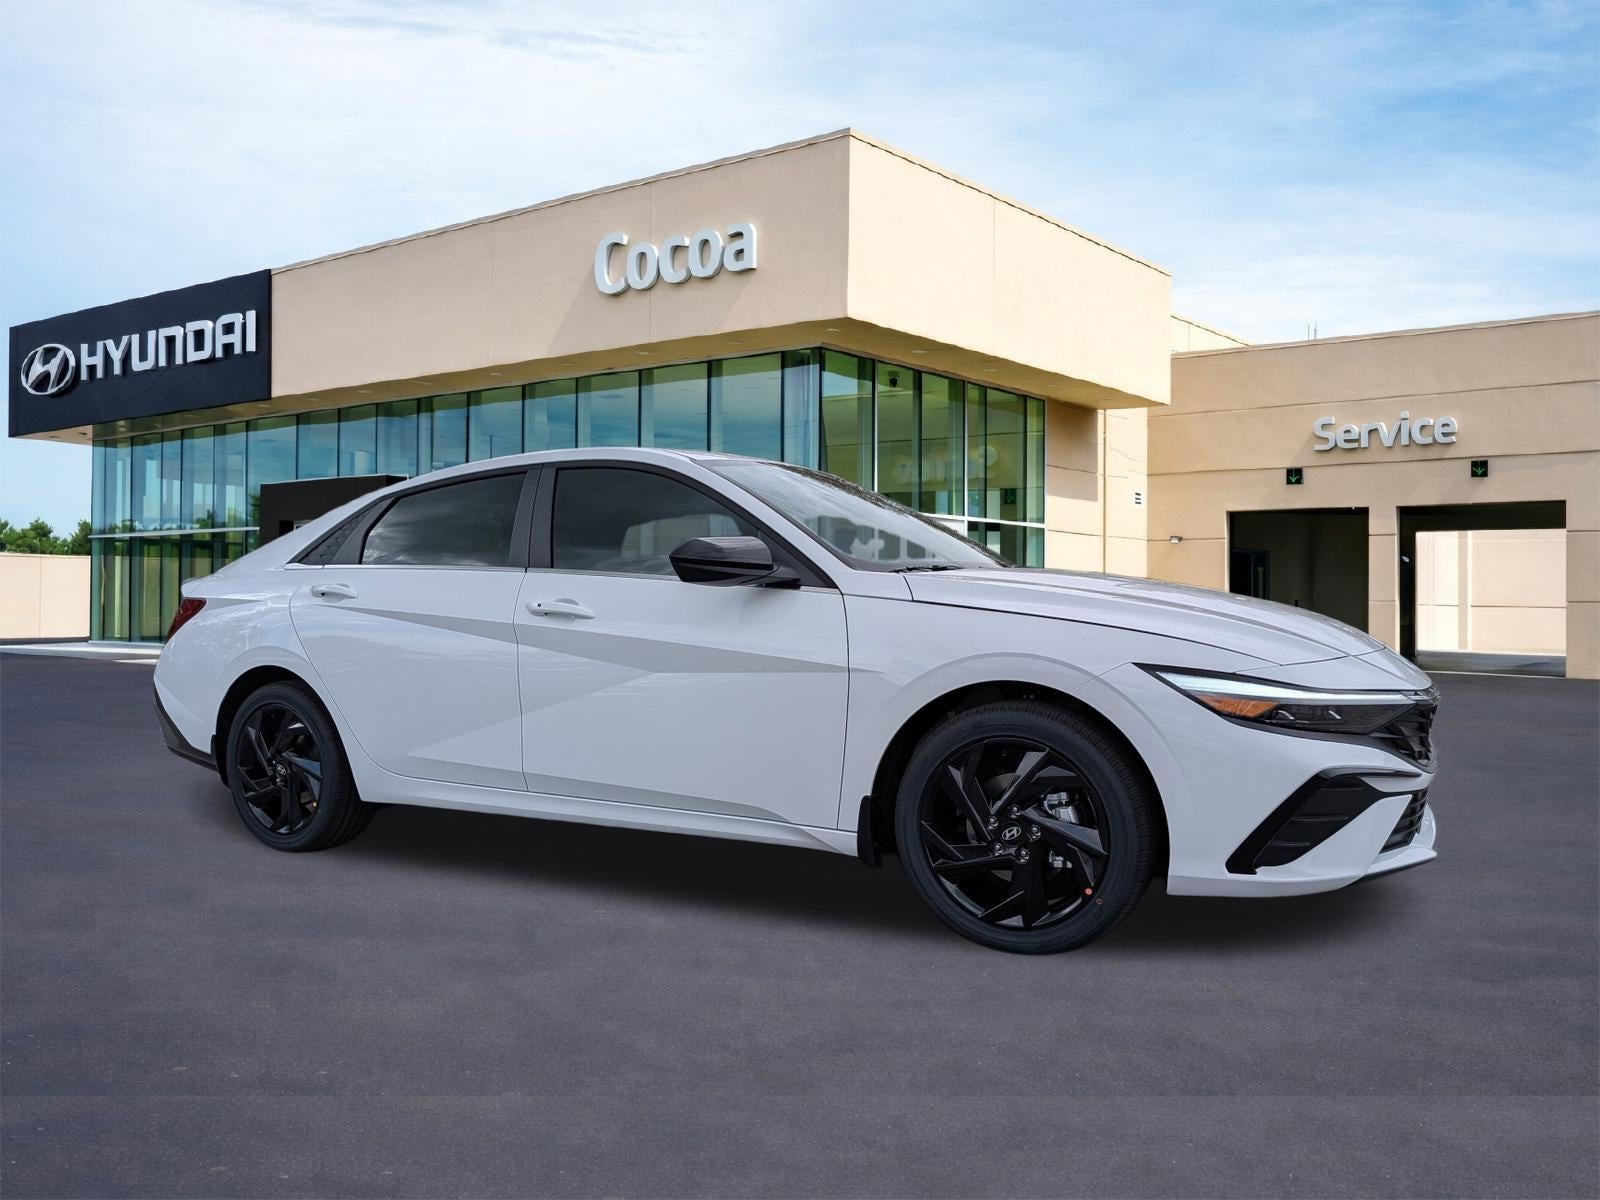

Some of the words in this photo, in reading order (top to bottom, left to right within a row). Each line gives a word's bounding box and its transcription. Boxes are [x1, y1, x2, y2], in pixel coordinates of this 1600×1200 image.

[594, 223, 757, 295] Cocoa
[80, 310, 256, 381] HYUNDAI
[1312, 410, 1458, 451] Service
